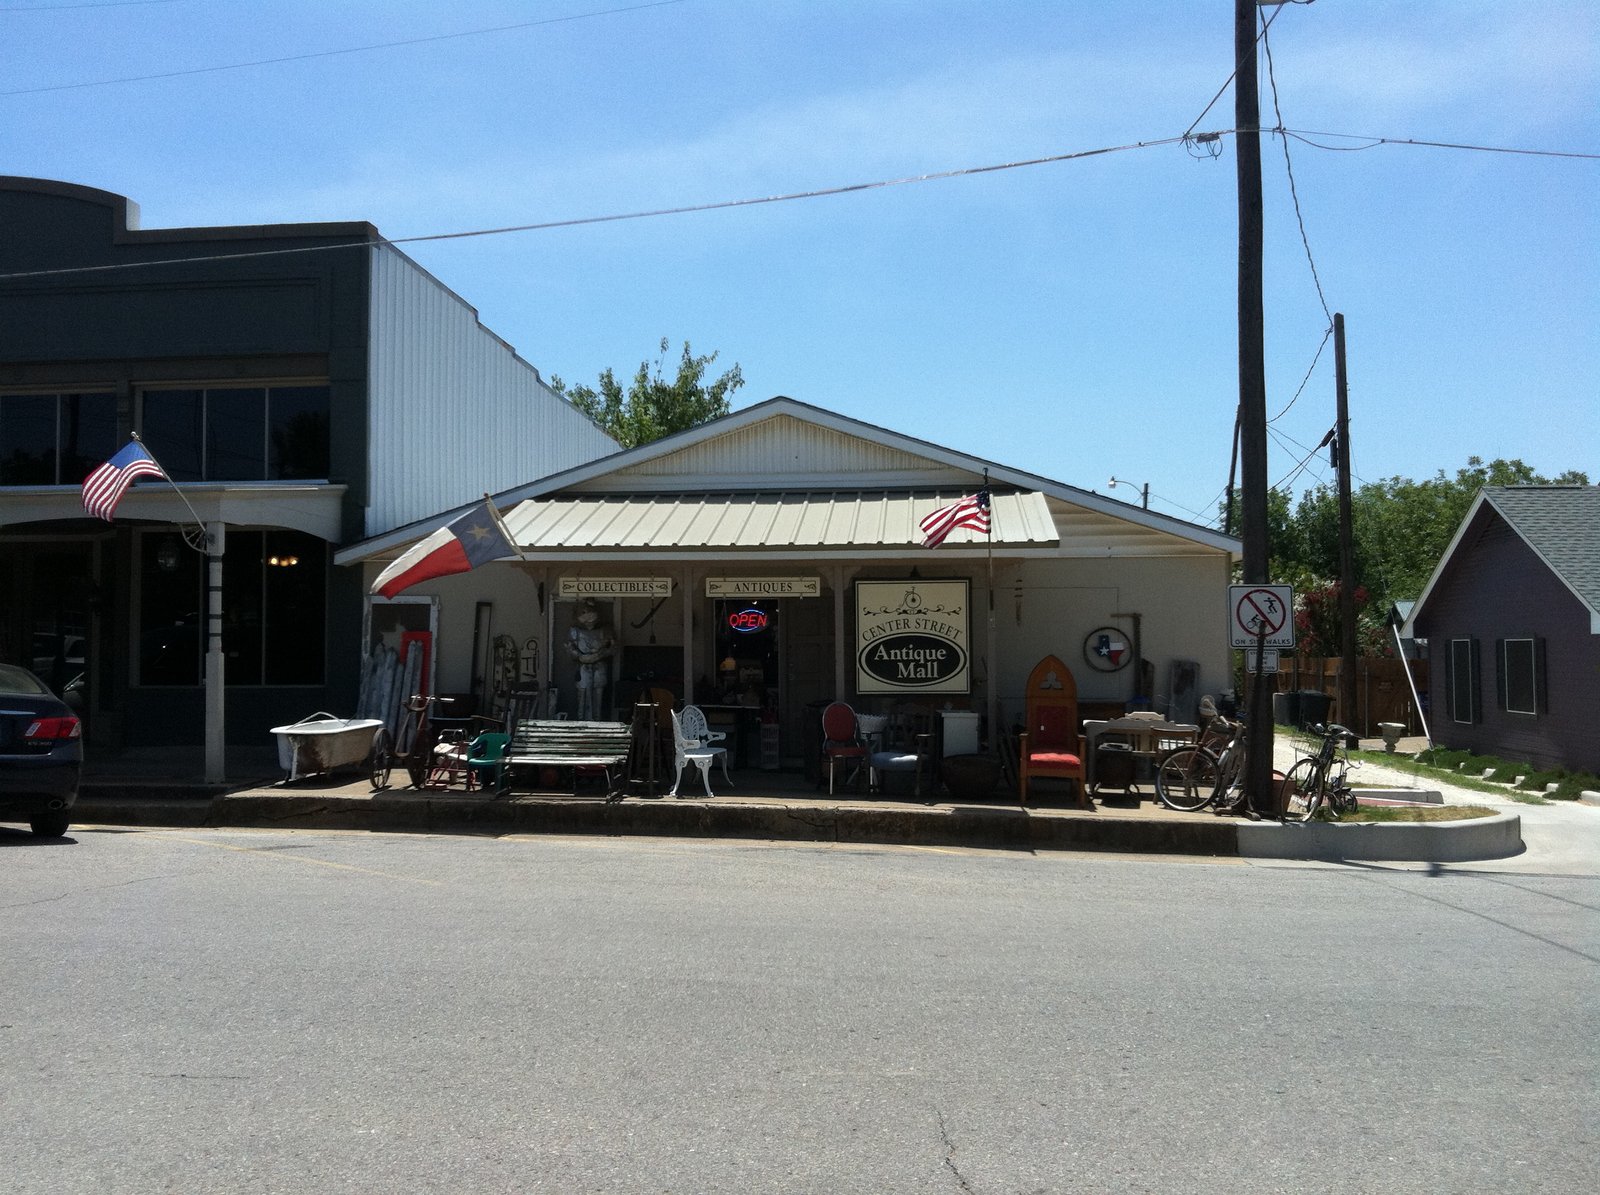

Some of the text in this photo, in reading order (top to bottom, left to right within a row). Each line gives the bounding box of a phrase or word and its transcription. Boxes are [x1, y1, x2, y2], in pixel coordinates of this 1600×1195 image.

[576, 582, 654, 592] COLLECTIBLES
[734, 582, 793, 593] ANTIQUES
[729, 613, 768, 627] OPEN
[862, 618, 963, 642] CENTER STREET
[874, 644, 947, 664] Antique
[897, 661, 939, 679] Mall
